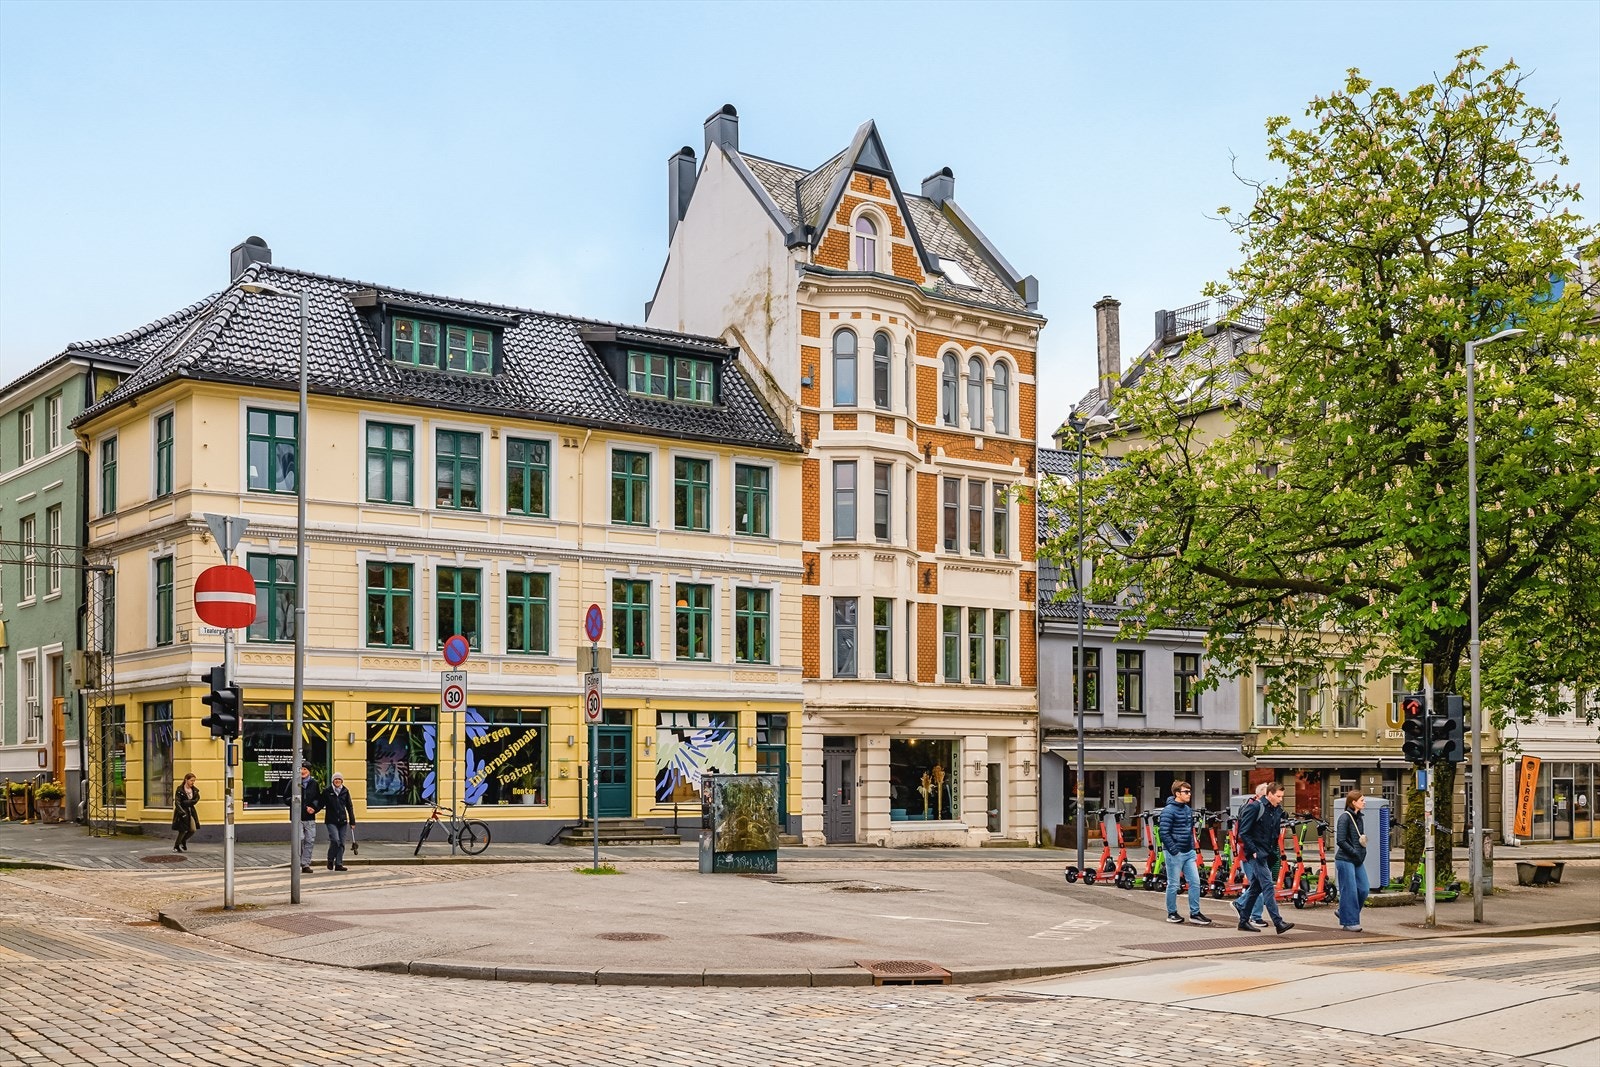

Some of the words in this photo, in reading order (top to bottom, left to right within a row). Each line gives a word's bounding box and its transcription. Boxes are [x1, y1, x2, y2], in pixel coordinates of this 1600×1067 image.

[588, 676, 599, 685] Sone
[448, 691, 460, 703] 30
[590, 697, 598, 711] 30
[472, 726, 511, 747] Bergen
[469, 728, 538, 787] Internasjonale
[496, 763, 533, 786] Teater
